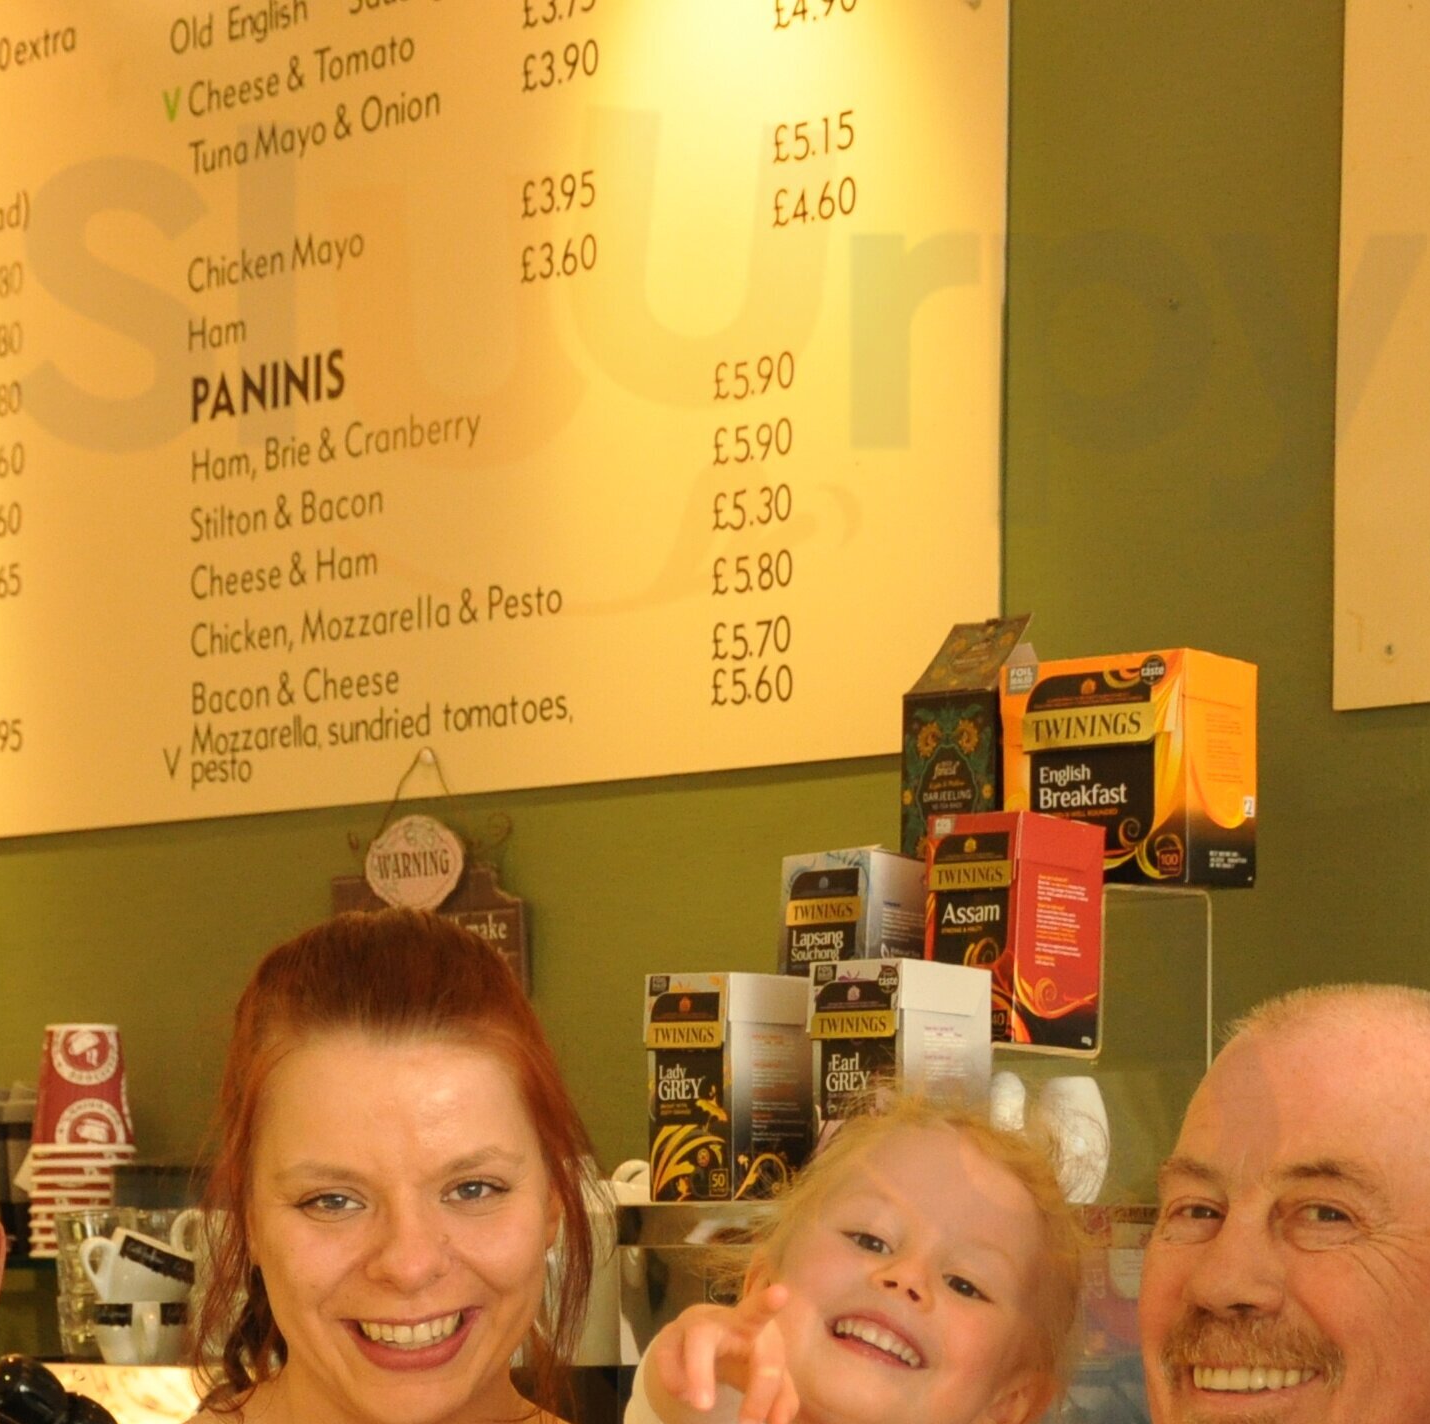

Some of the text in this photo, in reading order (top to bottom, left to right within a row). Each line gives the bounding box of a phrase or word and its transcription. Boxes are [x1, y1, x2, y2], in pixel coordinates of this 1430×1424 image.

[170, 9, 213, 56] Old
[189, 35, 599, 118] Cheese Tomato £3.90
[189, 87, 855, 176] Tuna Mayo Onion £5.15
[523, 171, 857, 228] £3.95 £4.60
[188, 228, 597, 294] Chicken Mayo £3.60
[190, 348, 795, 423] PANINIS £5.90
[191, 409, 792, 486] Ham, Brie Cranberry £5.90
[191, 483, 792, 543] Stilton Bacon £5.30
[191, 545, 792, 600] Cheese Ham £5.80
[191, 583, 791, 664] Chicken, Mozzarella Pesto £5.70
[191, 663, 793, 716] Bacon Cheese £5.60
[328, 693, 431, 748] sundried
[1032, 711, 1142, 743] TWININGS
[191, 755, 252, 791] pesto
[1039, 765, 1091, 785] English
[1039, 784, 1127, 810] Breakfast
[376, 849, 450, 880] WARNING
[936, 867, 1003, 885] TWININGS
[794, 903, 853, 920] TWININGS
[941, 903, 1000, 924] Assam
[791, 948, 839, 962] Souchong
[792, 930, 843, 949] Lapsang
[654, 1027, 714, 1043] TWININGS
[820, 1016, 887, 1033] TWININGS
[659, 1064, 687, 1080] Lady
[832, 1053, 859, 1072] Earl
[658, 1079, 702, 1101] GREY
[826, 1071, 870, 1092] GREY
